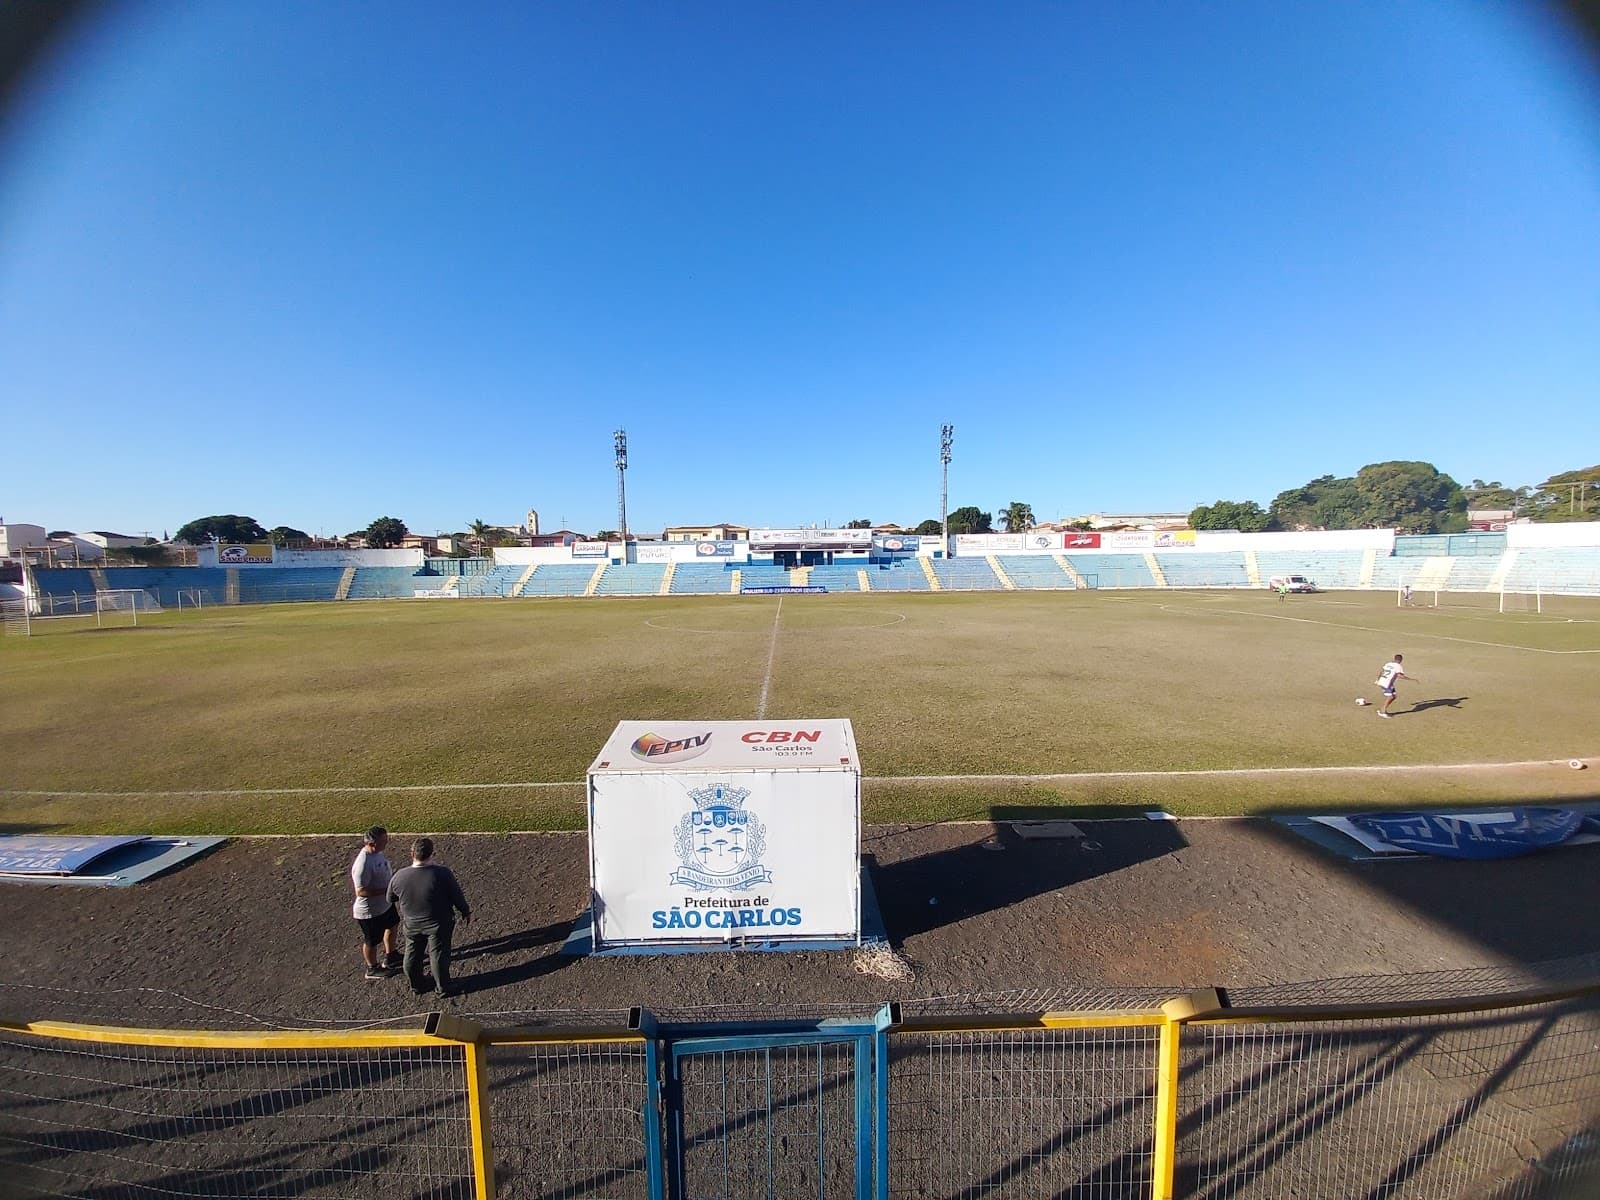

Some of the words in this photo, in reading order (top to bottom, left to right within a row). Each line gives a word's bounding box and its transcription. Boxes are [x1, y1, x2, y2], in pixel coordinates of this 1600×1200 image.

[647, 731, 713, 757] EPTV
[740, 730, 822, 744] CBN
[752, 744, 773, 752] São
[684, 897, 751, 908] Prefeitura
[753, 895, 769, 906] de
[652, 906, 702, 929] SÃO
[705, 907, 802, 929] CARLOS
